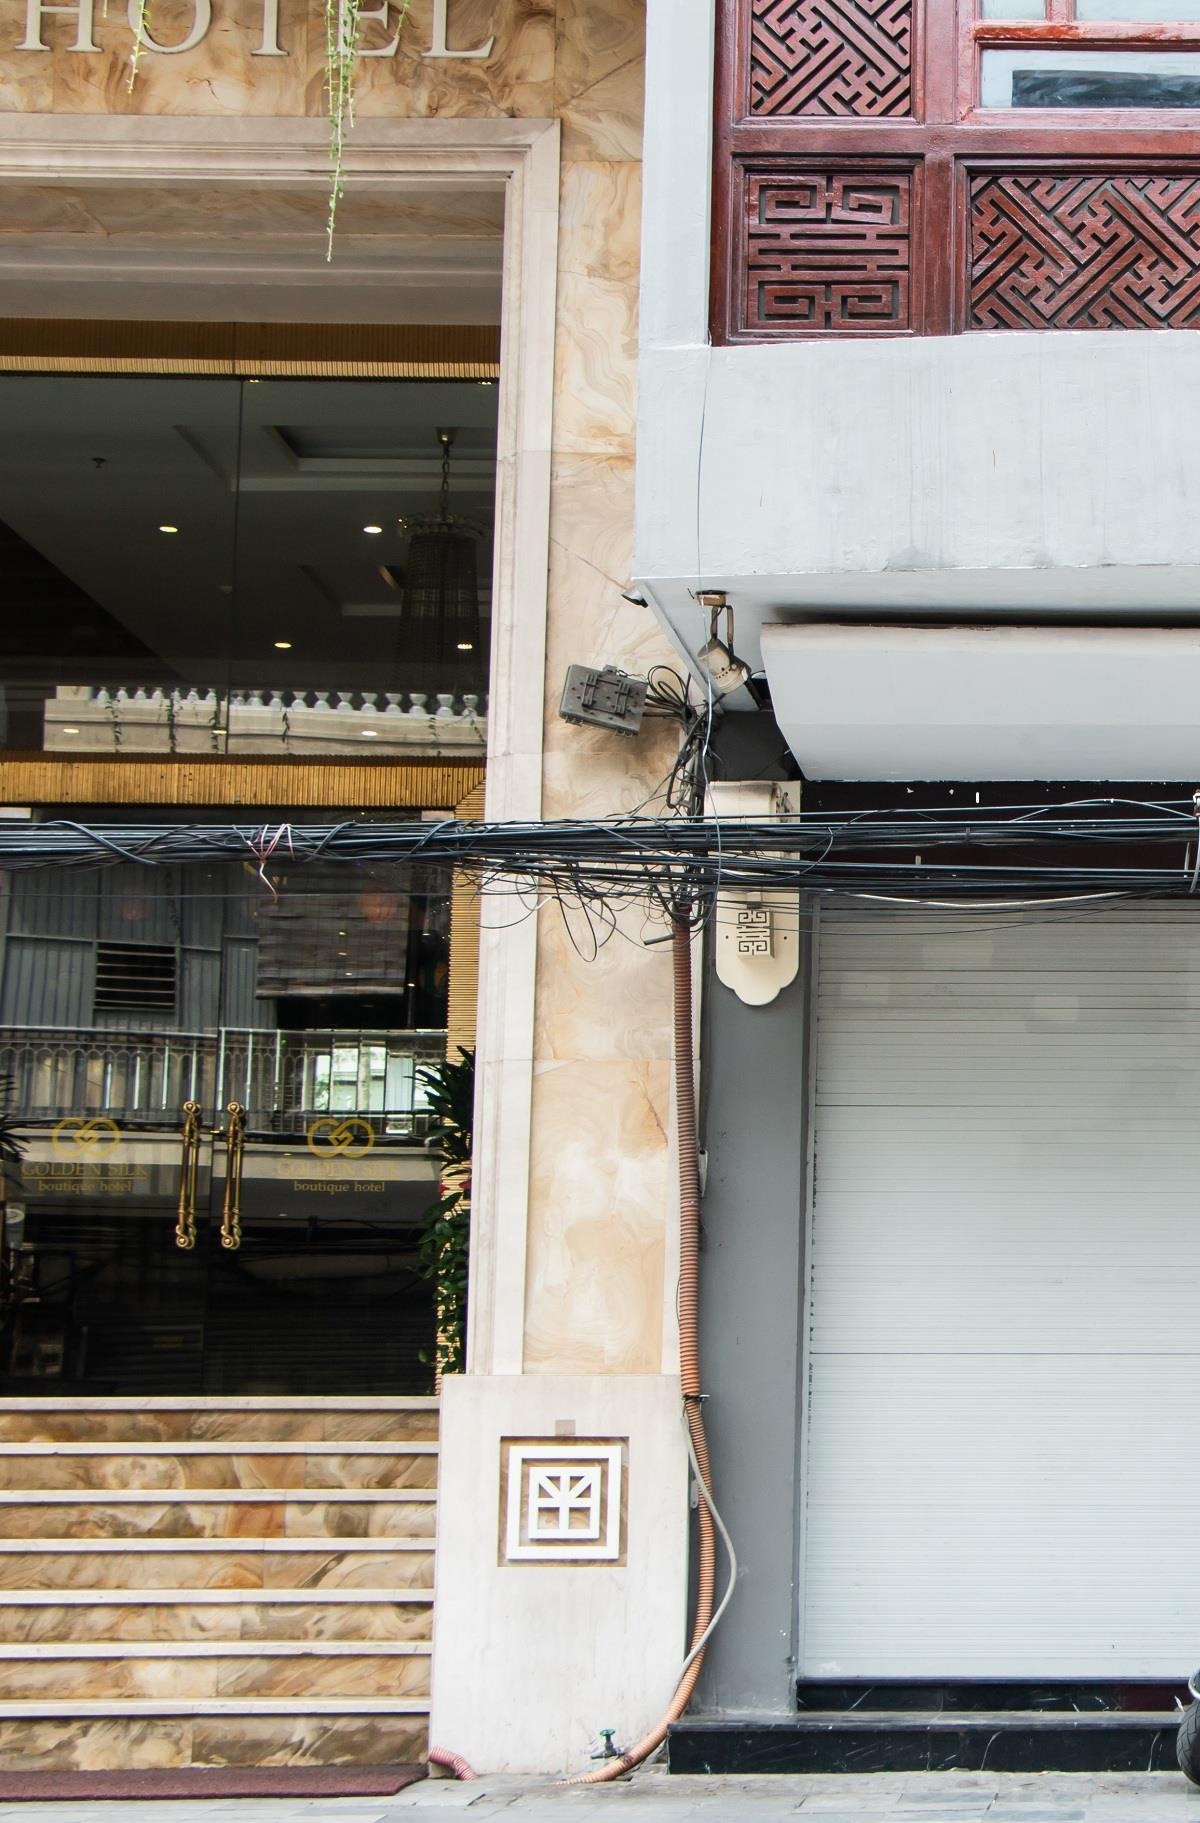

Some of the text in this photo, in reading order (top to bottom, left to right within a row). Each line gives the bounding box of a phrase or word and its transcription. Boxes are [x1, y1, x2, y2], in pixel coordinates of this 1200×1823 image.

[22, 1161, 100, 1176] GOLDEN
[38, 1180, 132, 1194] boutique hotel
[293, 1180, 385, 1195] boutique hotel
